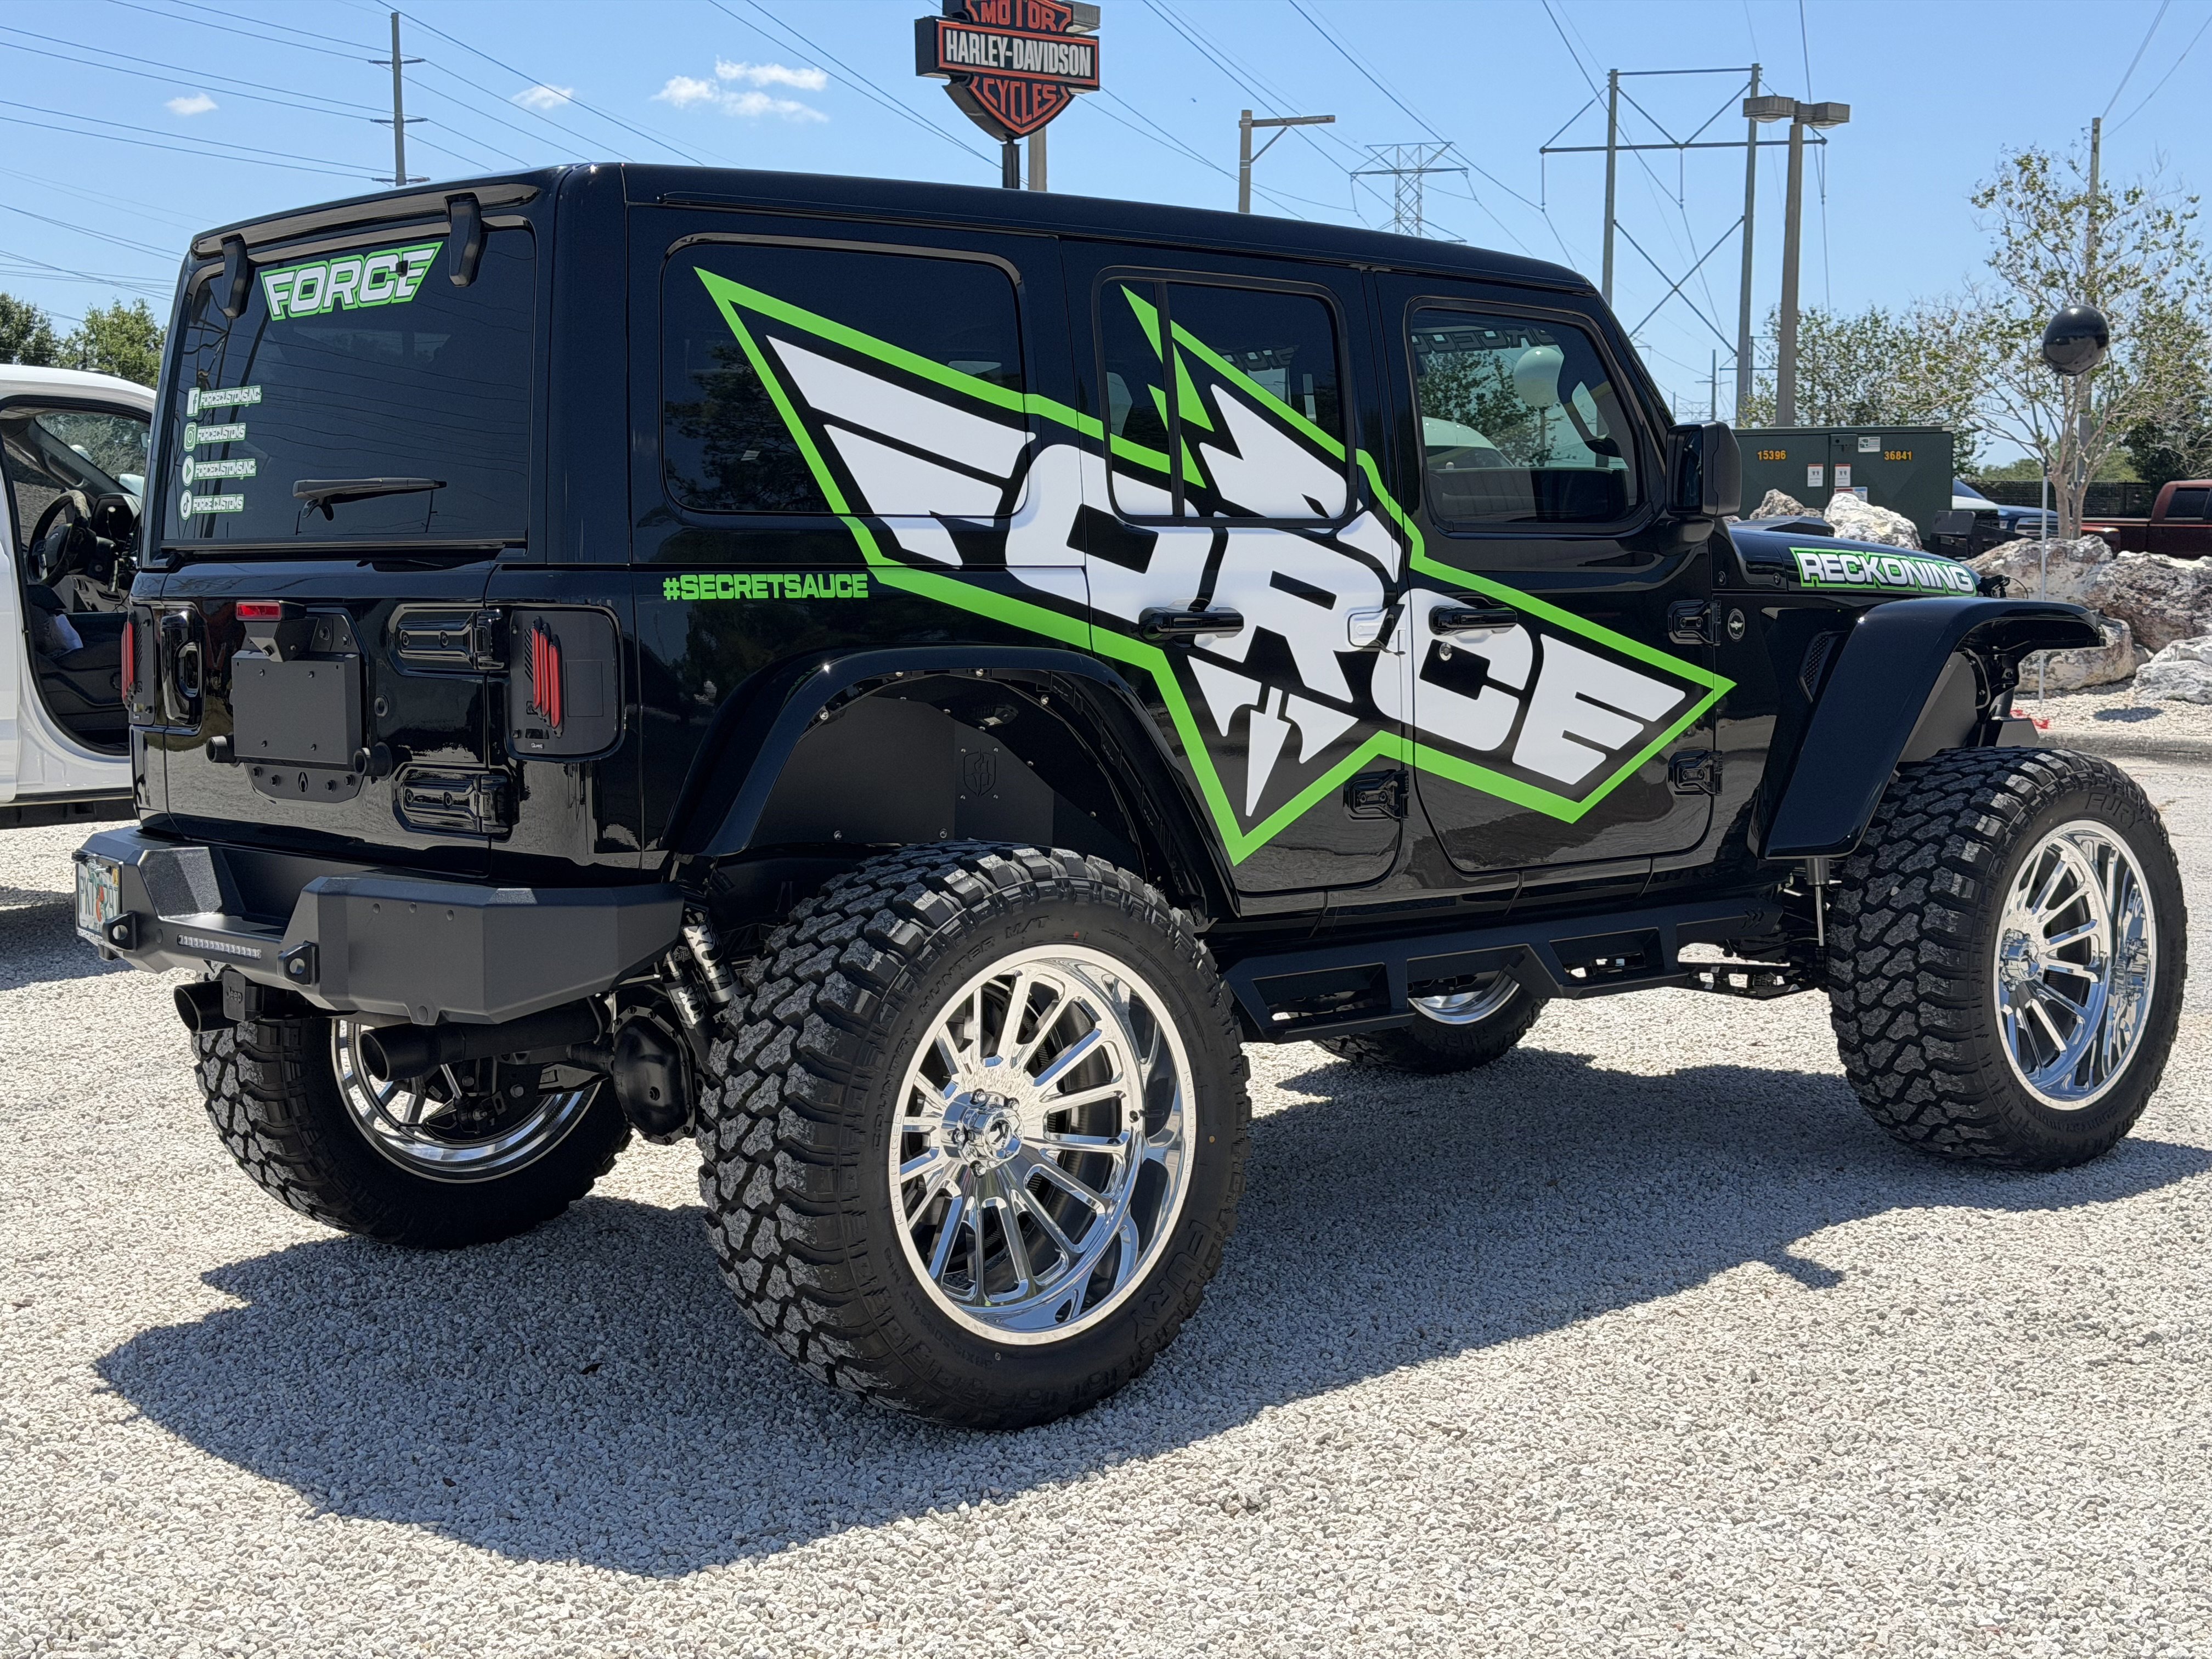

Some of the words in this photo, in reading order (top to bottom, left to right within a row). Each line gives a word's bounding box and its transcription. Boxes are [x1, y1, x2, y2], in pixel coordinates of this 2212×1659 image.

[980, 0, 1057, 32] MOTOR
[945, 30, 1092, 77] HARLEY-DAVIDSON
[982, 78, 1057, 125] CYCLES
[262, 246, 438, 317] FORCE
[1757, 450, 1786, 460] 15396
[1884, 450, 1912, 460] 36841
[765, 332, 1687, 790] FORCE
[1795, 551, 1975, 594] RECKONING
[663, 573, 868, 600] #SECRETSAUCE
[225, 985, 243, 1005] Jeep
